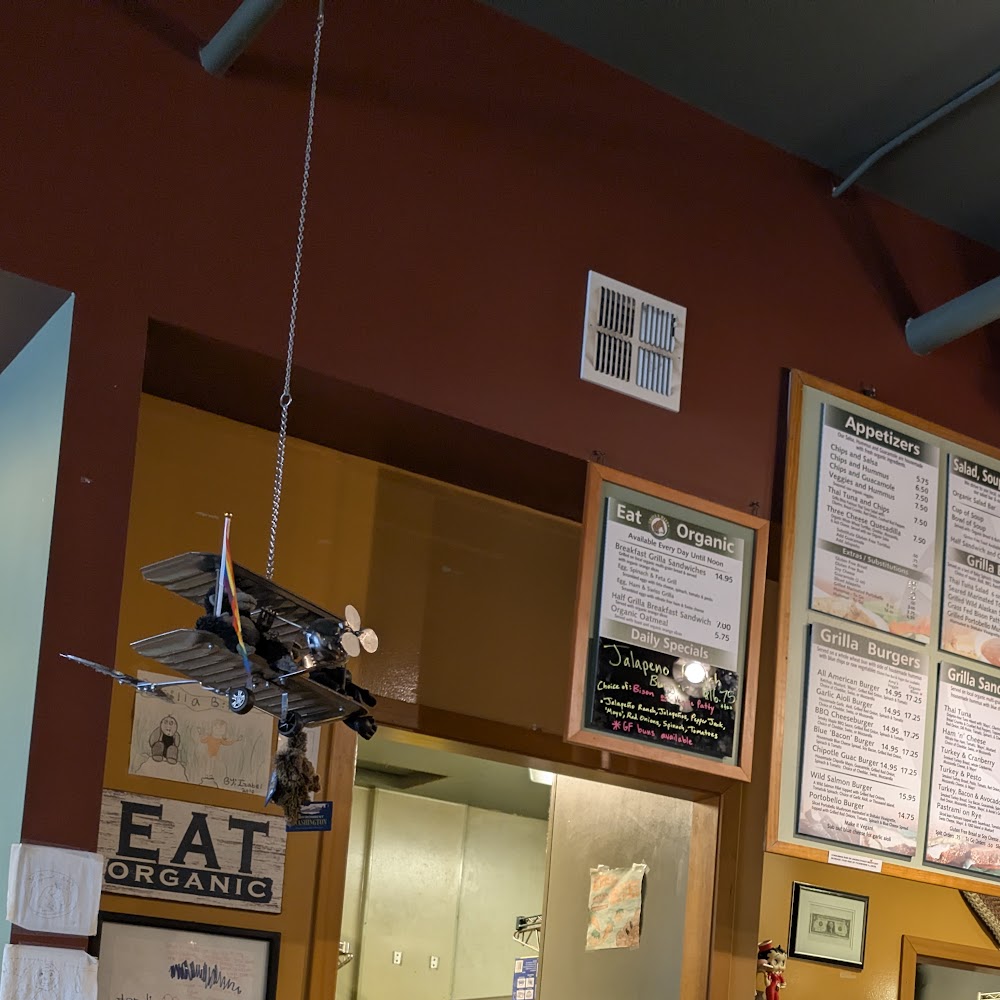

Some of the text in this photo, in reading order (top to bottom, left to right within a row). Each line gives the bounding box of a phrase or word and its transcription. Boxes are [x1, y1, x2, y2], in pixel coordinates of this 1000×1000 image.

[844, 416, 920, 455] Appetizers
[829, 452, 889, 480] Chips and Hummus
[830, 443, 878, 466] Chips and Salsa
[952, 456, 979, 480] Salad,
[915, 484, 928, 494] 6.50
[916, 475, 928, 485] 5.75
[616, 503, 735, 558] Eat Organic
[615, 541, 732, 583] Breakfast Grilla Sandwiches 14.95
[627, 532, 723, 567] Available Every Day Until Noon
[842, 547, 862, 559] Extras
[867, 556, 909, 575] Substitutions
[966, 554, 994, 573] Grilla
[629, 566, 648, 576] Spinach
[610, 603, 729, 641] Organic Oatmeal 5.75
[611, 591, 731, 630] Half Grilla Breakfast Sandwich 7.00
[630, 627, 708, 659] Daily Specials
[820, 628, 921, 673] Grilla Burgers
[596, 680, 620, 690] Choice
[632, 683, 654, 696] Bison
[817, 668, 921, 704] All American Burger 14.95 17.25
[947, 667, 975, 686] Grilla
[626, 711, 638, 720] Red
[687, 725, 718, 739] Tomatoes
[636, 724, 655, 736] buns
[660, 733, 692, 745] available
[810, 770, 915, 801] Wild Salmon Burger 15.95
[939, 764, 958, 777] Turkey
[966, 771, 981, 781] Pesto
[808, 790, 914, 820] Portobello Burger 14.75
[936, 801, 961, 813] Pastrami
[971, 810, 981, 819] Rye
[116, 801, 270, 874] EAT
[107, 861, 267, 898] ORGANIC
